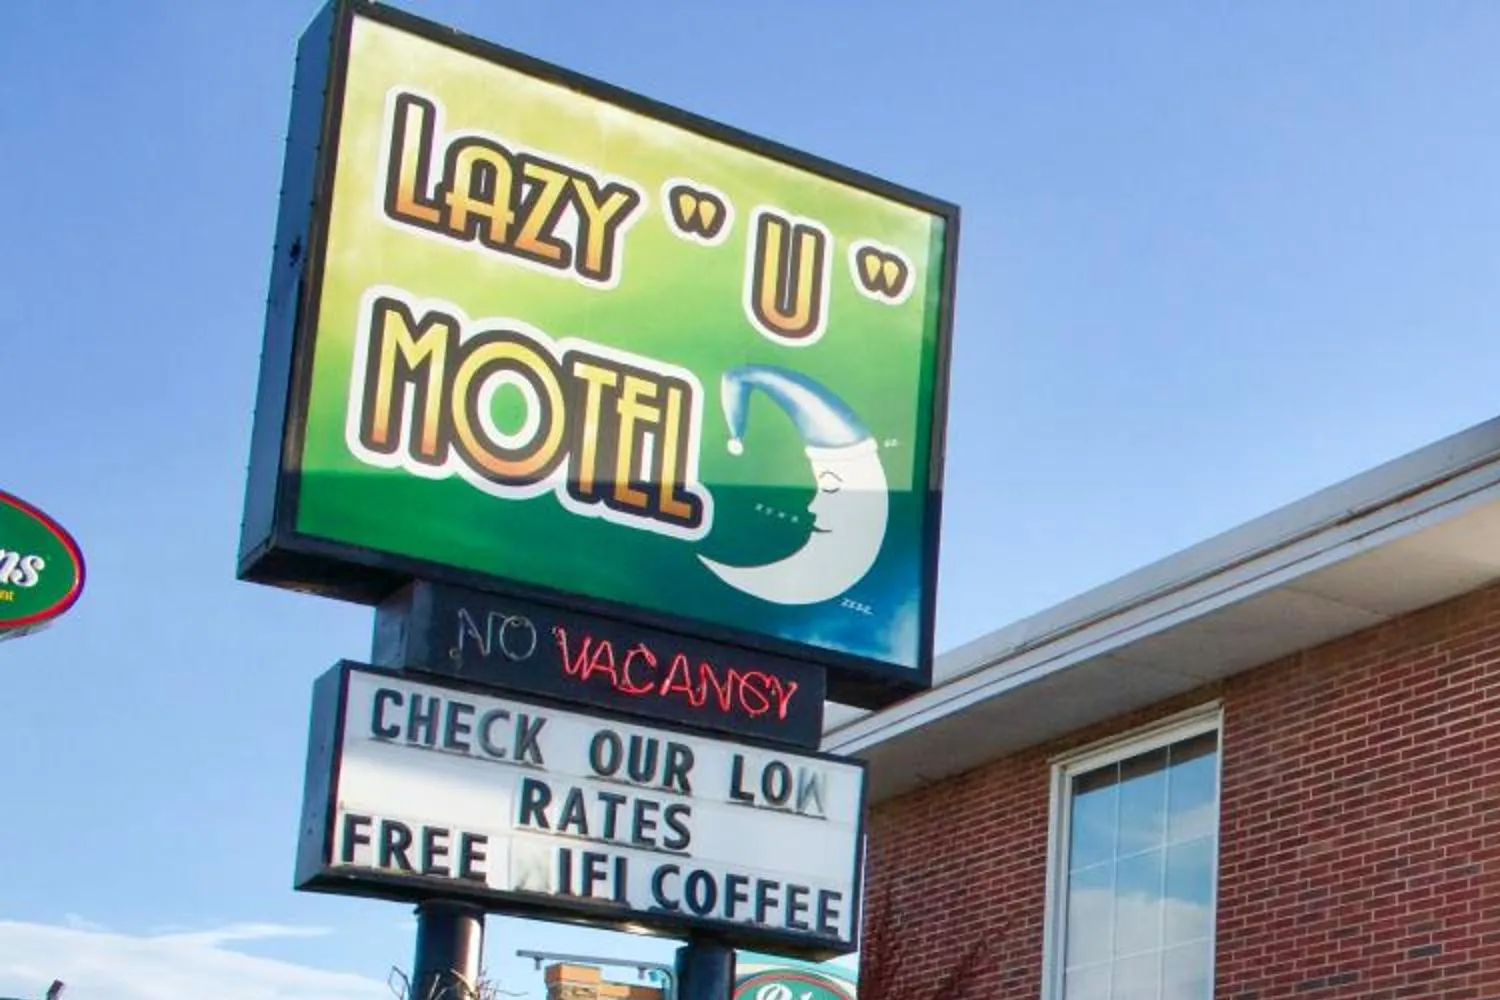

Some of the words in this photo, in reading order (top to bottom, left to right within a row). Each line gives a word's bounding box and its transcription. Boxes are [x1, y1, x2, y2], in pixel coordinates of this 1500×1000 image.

[384, 92, 640, 283] LAZY
[361, 297, 703, 529] MOTEL
[450, 608, 537, 664] NO
[370, 688, 547, 764] CHECK
[589, 728, 696, 798] OUR
[518, 777, 692, 850] RATES
[342, 812, 488, 882] FREE
[651, 862, 843, 935] COFFEE
